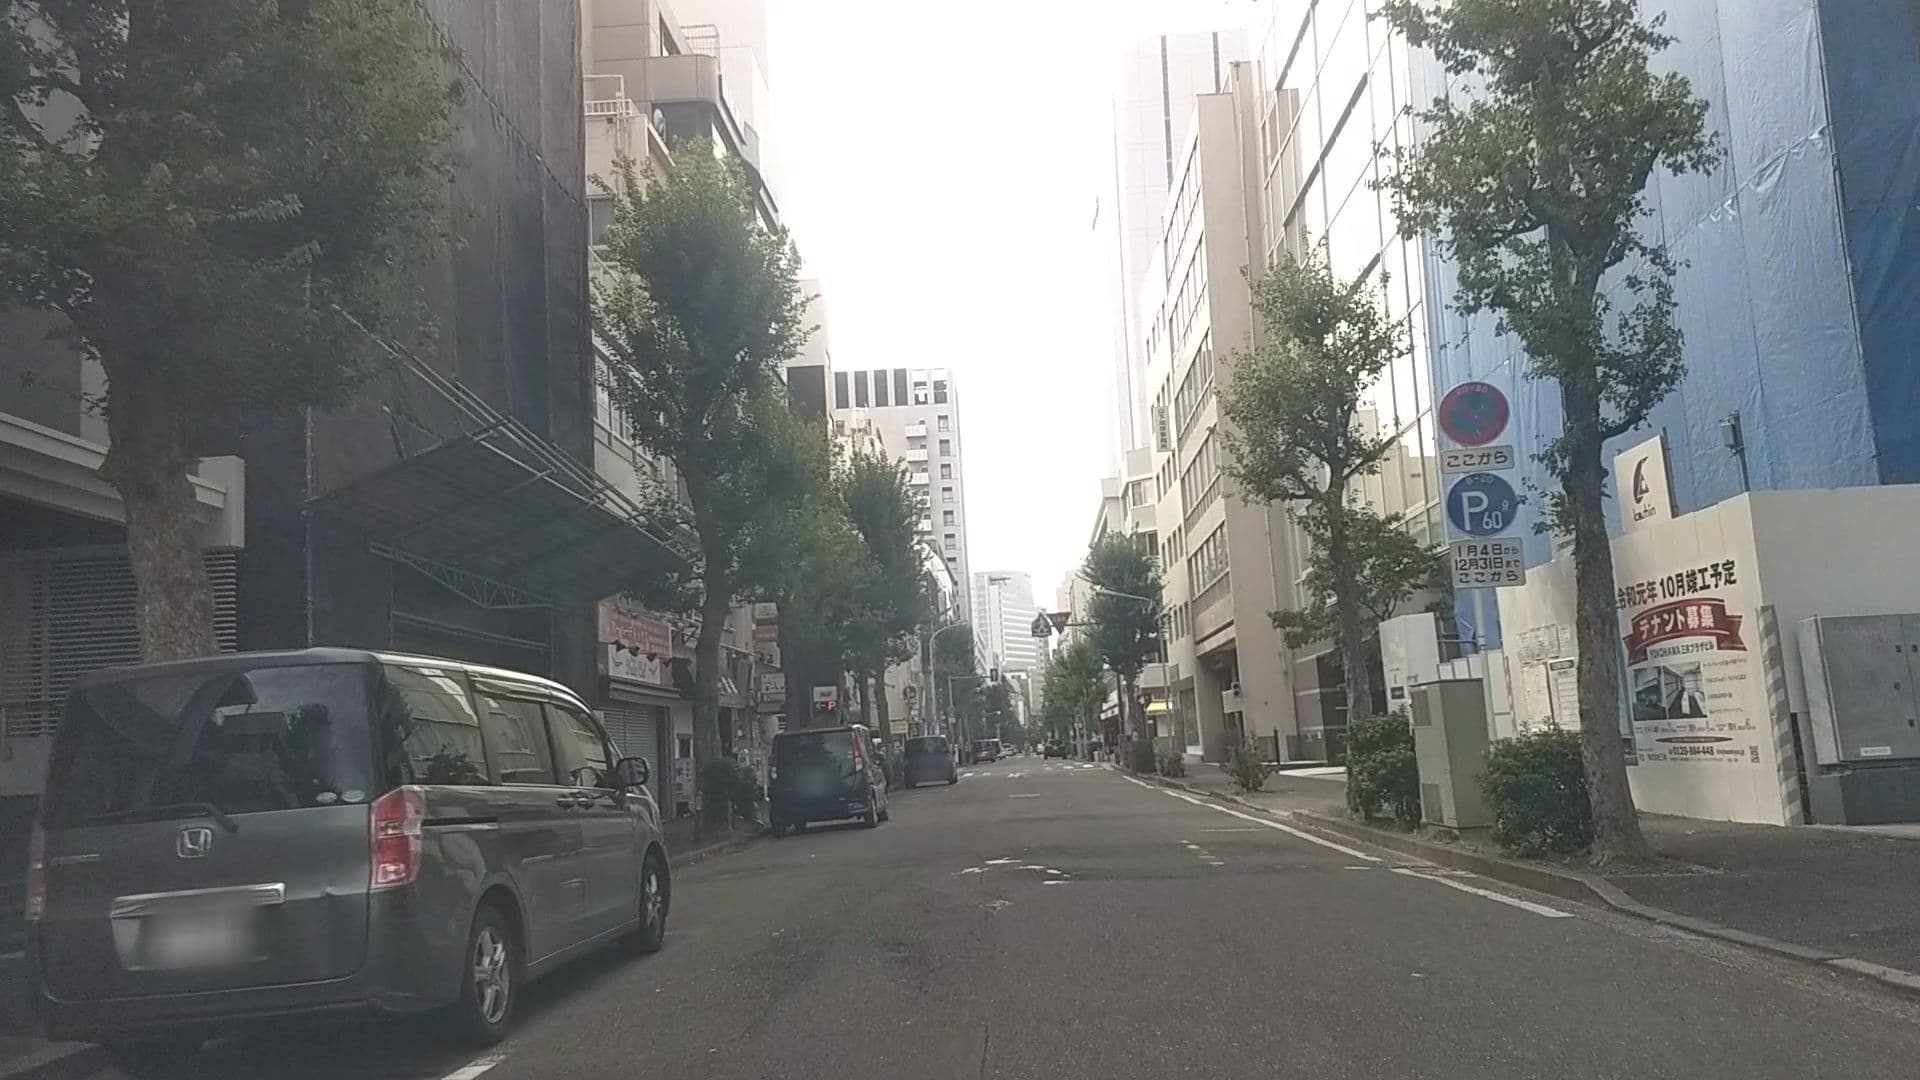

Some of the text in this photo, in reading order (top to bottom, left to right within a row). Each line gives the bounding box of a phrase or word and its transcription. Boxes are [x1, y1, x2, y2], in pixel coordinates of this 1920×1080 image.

[1447, 450, 1508, 468] ここから
[1461, 490, 1489, 531] P
[1482, 511, 1503, 530] 60
[1458, 543, 1519, 558] 1月4日から
[1454, 556, 1520, 571] 12月31日まで
[1459, 570, 1519, 584] ここから
[1659, 559, 1737, 599] 10月竣工予定
[1639, 604, 1715, 640] テナント募集
[827, 700, 837, 710] P
